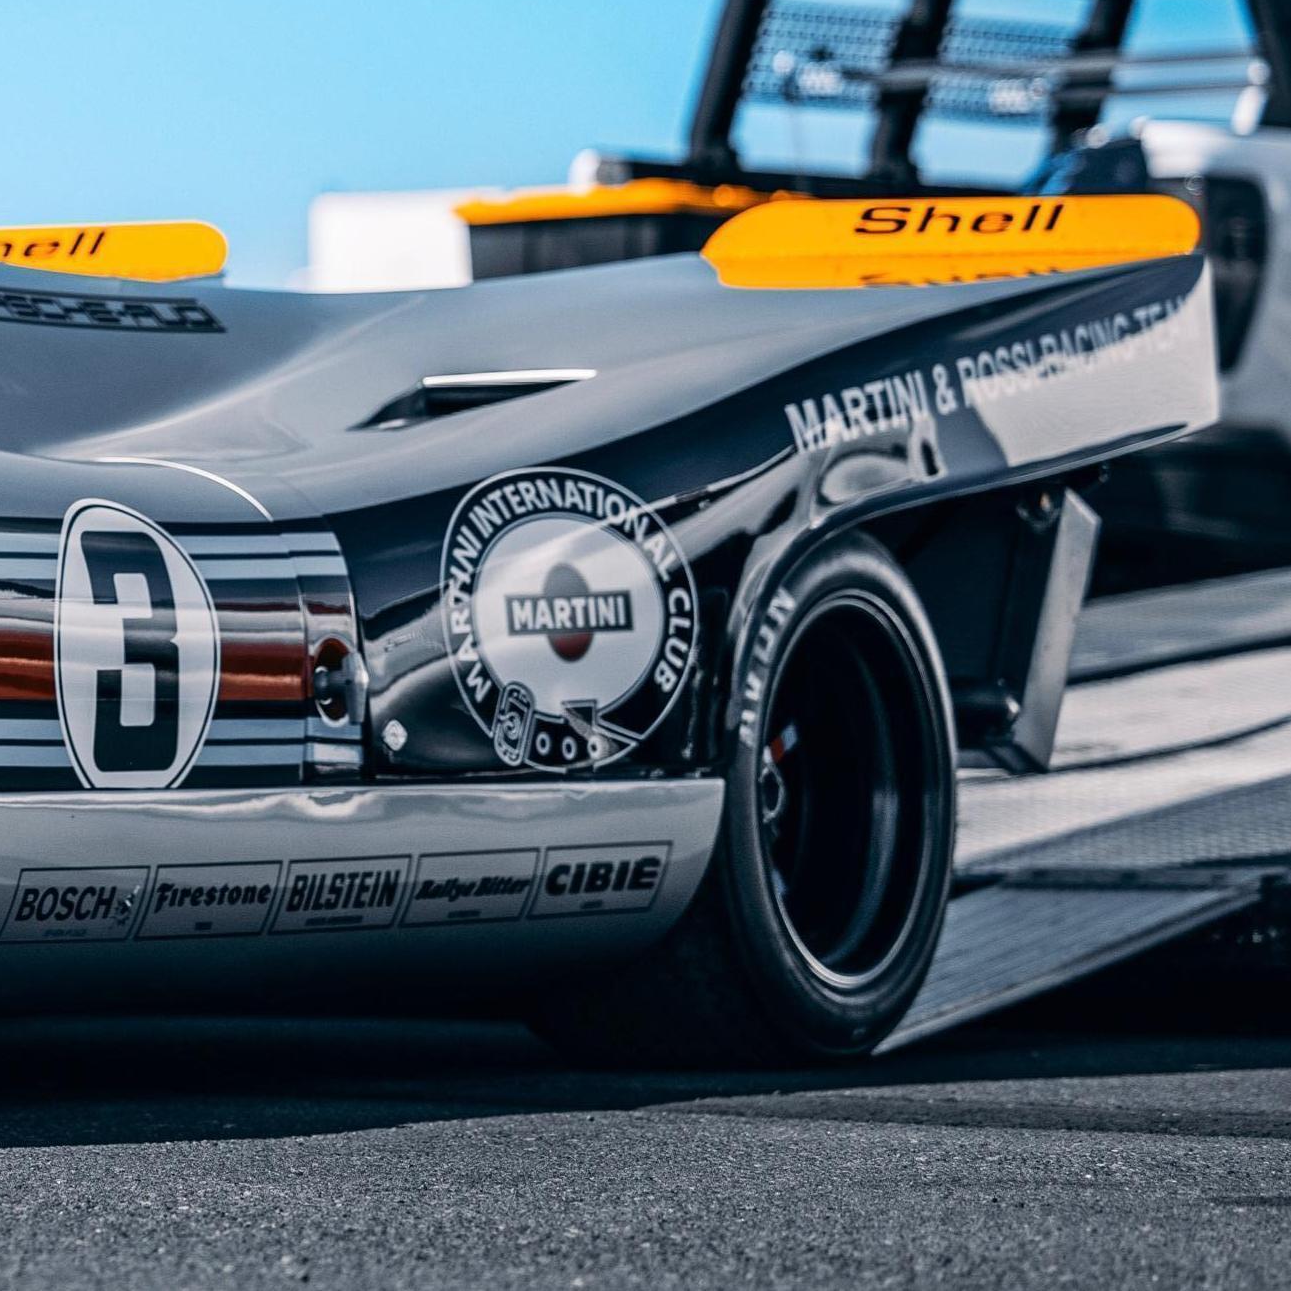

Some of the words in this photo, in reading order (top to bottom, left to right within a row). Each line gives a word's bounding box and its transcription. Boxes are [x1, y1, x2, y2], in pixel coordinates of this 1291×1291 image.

[854, 204, 1066, 235] Shell
[784, 369, 931, 454] MARTINI
[932, 363, 957, 416] &
[468, 477, 679, 582] INTERNATIONAL
[448, 525, 492, 703] MARTINI
[509, 594, 627, 631] MARTINI
[654, 587, 692, 693] CLUB
[81, 531, 181, 772] 3
[15, 886, 117, 922] BOSCH
[154, 882, 272, 914] Firestone
[285, 870, 401, 912] BILSTEIN
